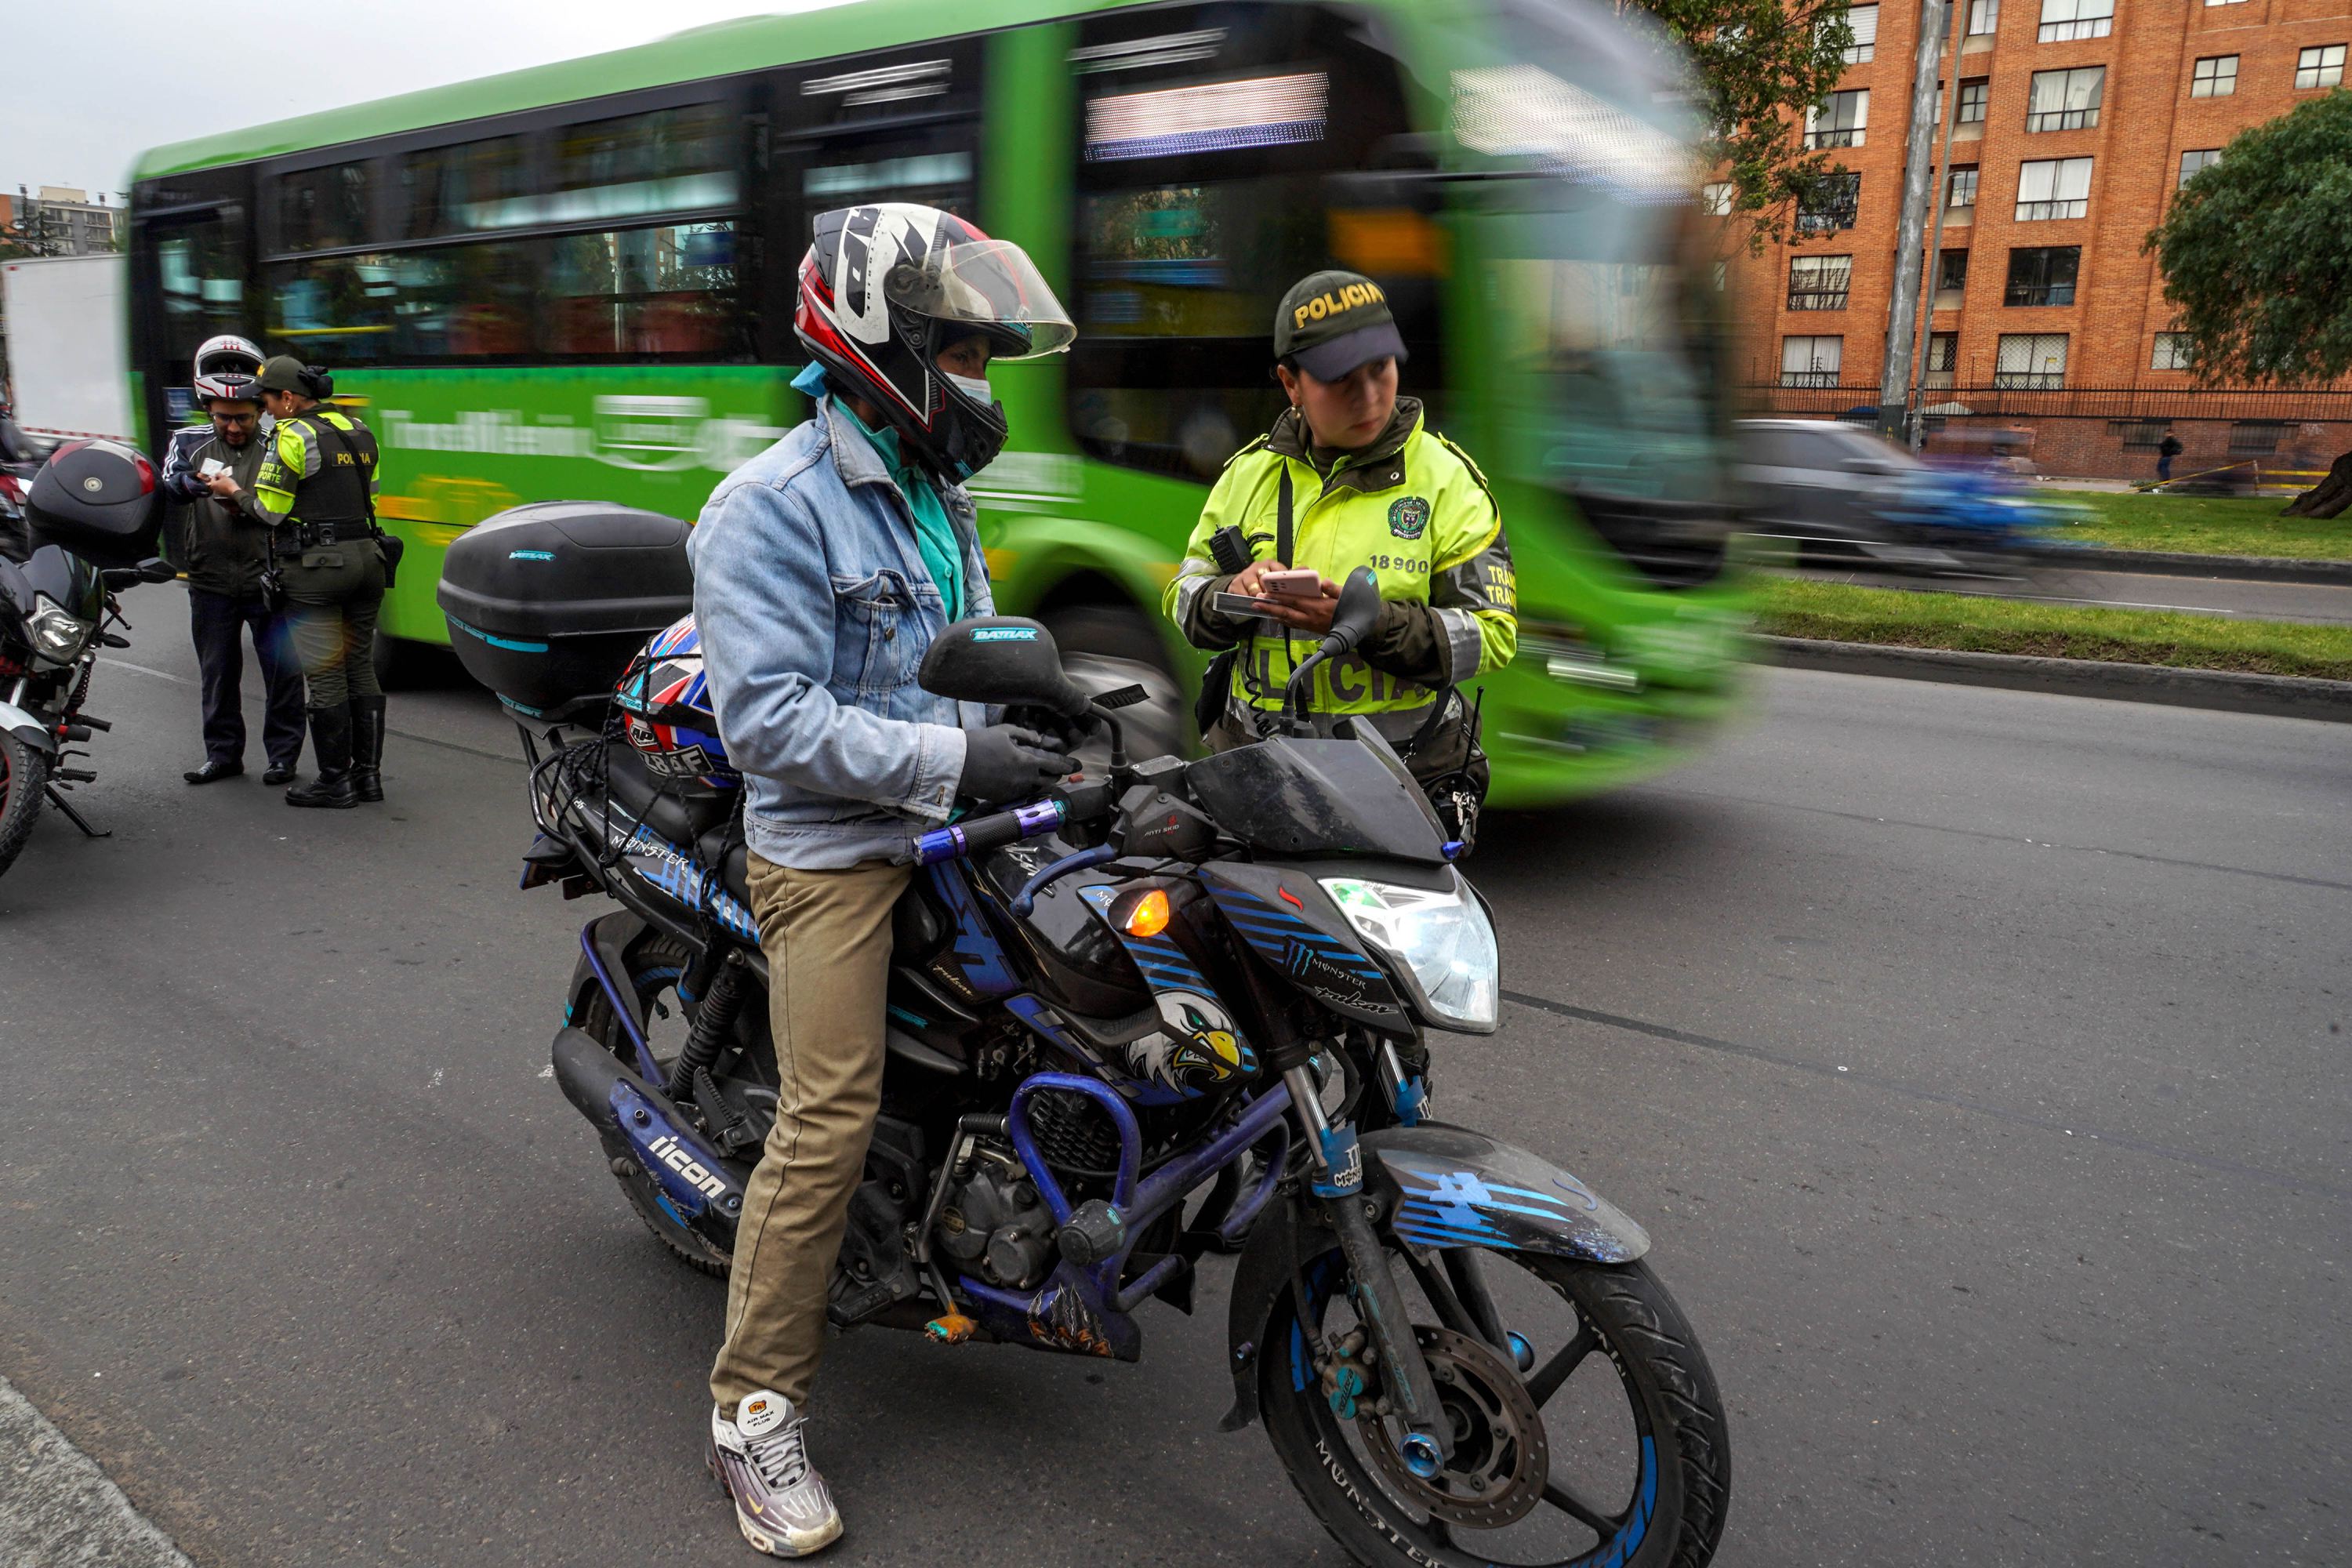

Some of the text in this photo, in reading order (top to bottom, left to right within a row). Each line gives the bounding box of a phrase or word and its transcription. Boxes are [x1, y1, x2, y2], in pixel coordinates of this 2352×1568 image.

[1294, 281, 1385, 329] POLICIA
[337, 452, 371, 465] POLIA
[611, 834, 689, 872] MONSTER
[1312, 957, 1367, 990] MONSTER
